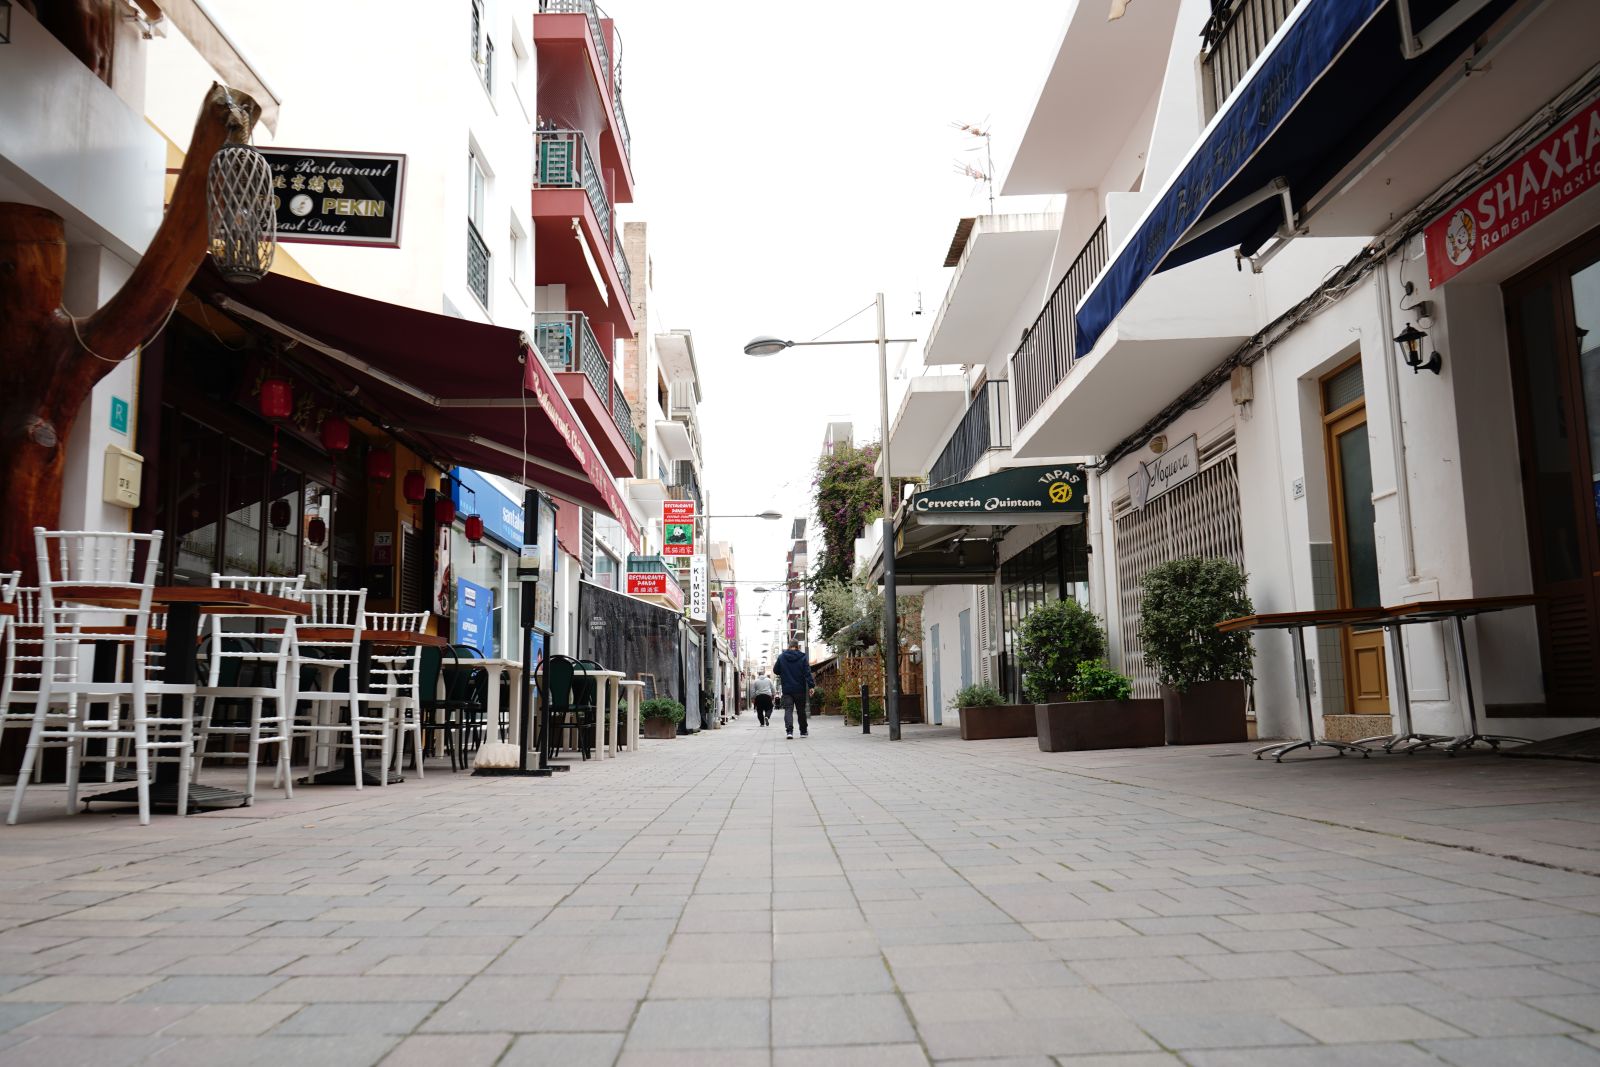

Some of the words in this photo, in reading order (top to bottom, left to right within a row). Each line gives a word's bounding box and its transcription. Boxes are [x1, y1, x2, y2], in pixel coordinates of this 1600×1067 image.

[294, 159, 391, 176] Restaurant
[321, 198, 385, 217] PEKIN
[307, 218, 347, 233] Duck
[115, 403, 124, 422] R
[1038, 470, 1080, 484] TAPAS
[984, 497, 1042, 510] Quintana
[378, 535, 390, 544] 37
